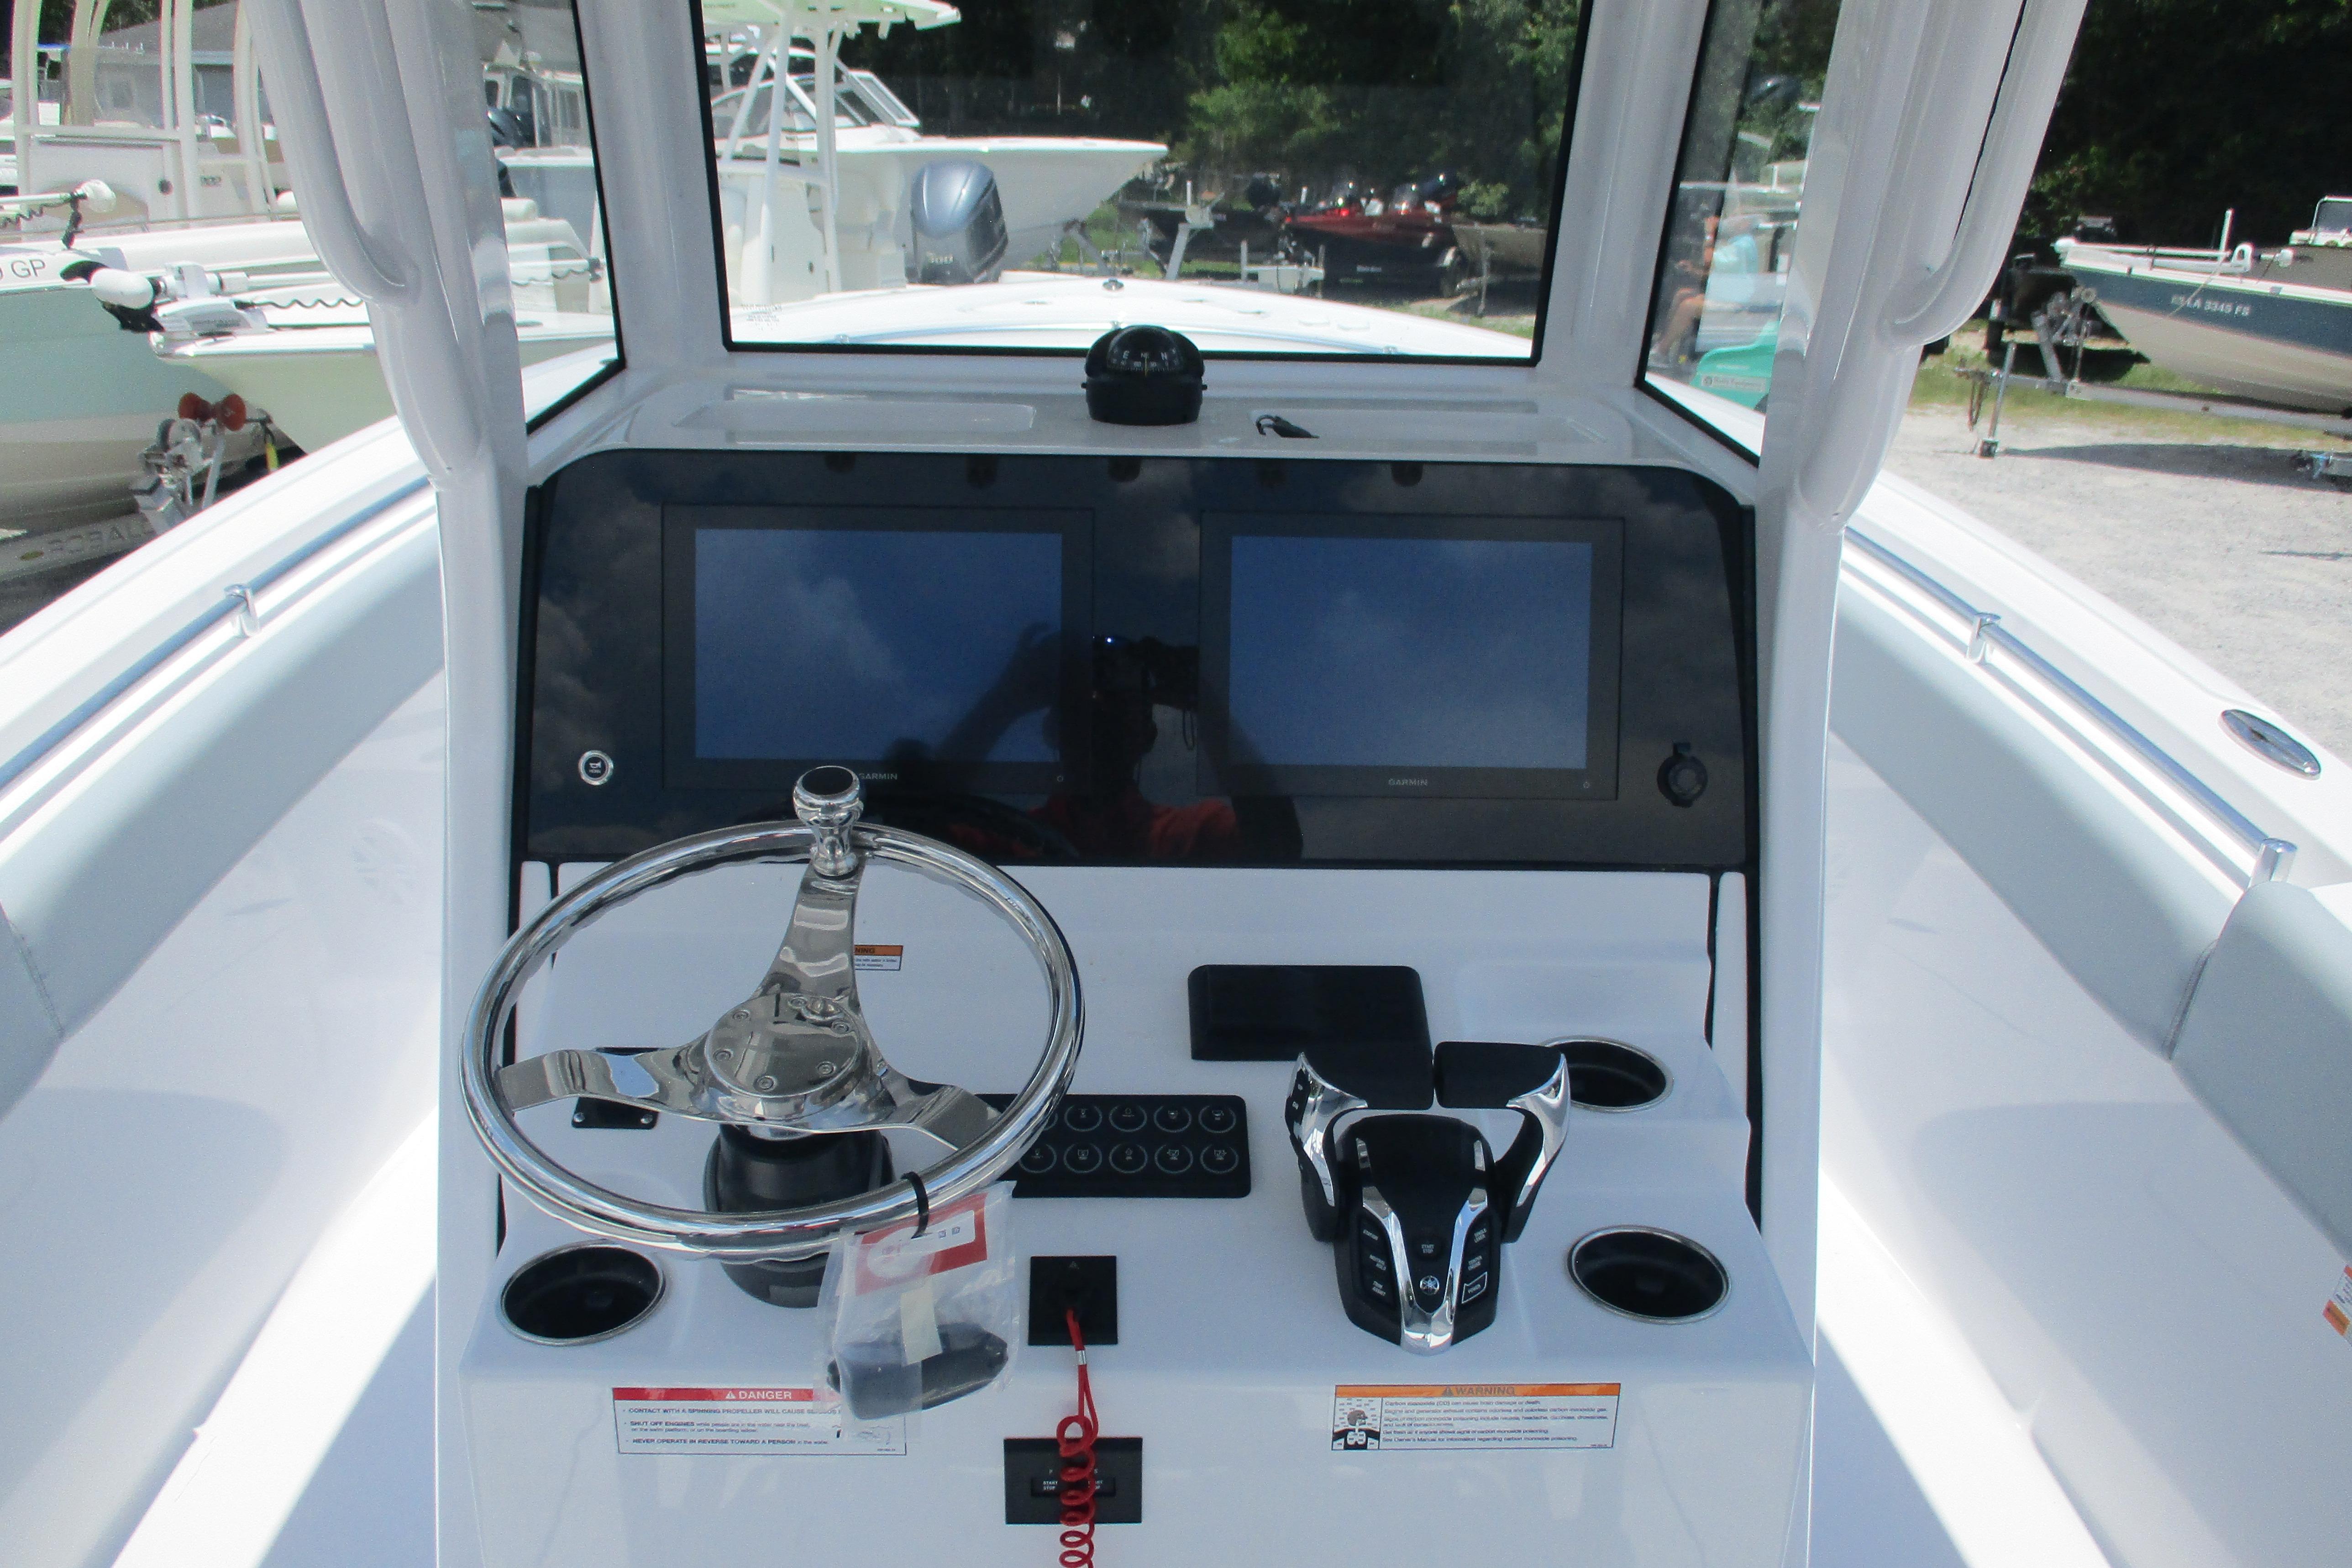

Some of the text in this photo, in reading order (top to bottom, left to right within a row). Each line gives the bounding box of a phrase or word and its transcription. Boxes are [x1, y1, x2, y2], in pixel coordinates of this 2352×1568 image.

[11, 259, 46, 278] GP
[1161, 352, 1167, 360] N
[739, 1390, 792, 1400] DANGER
[1455, 1386, 1515, 1395] WARNING
